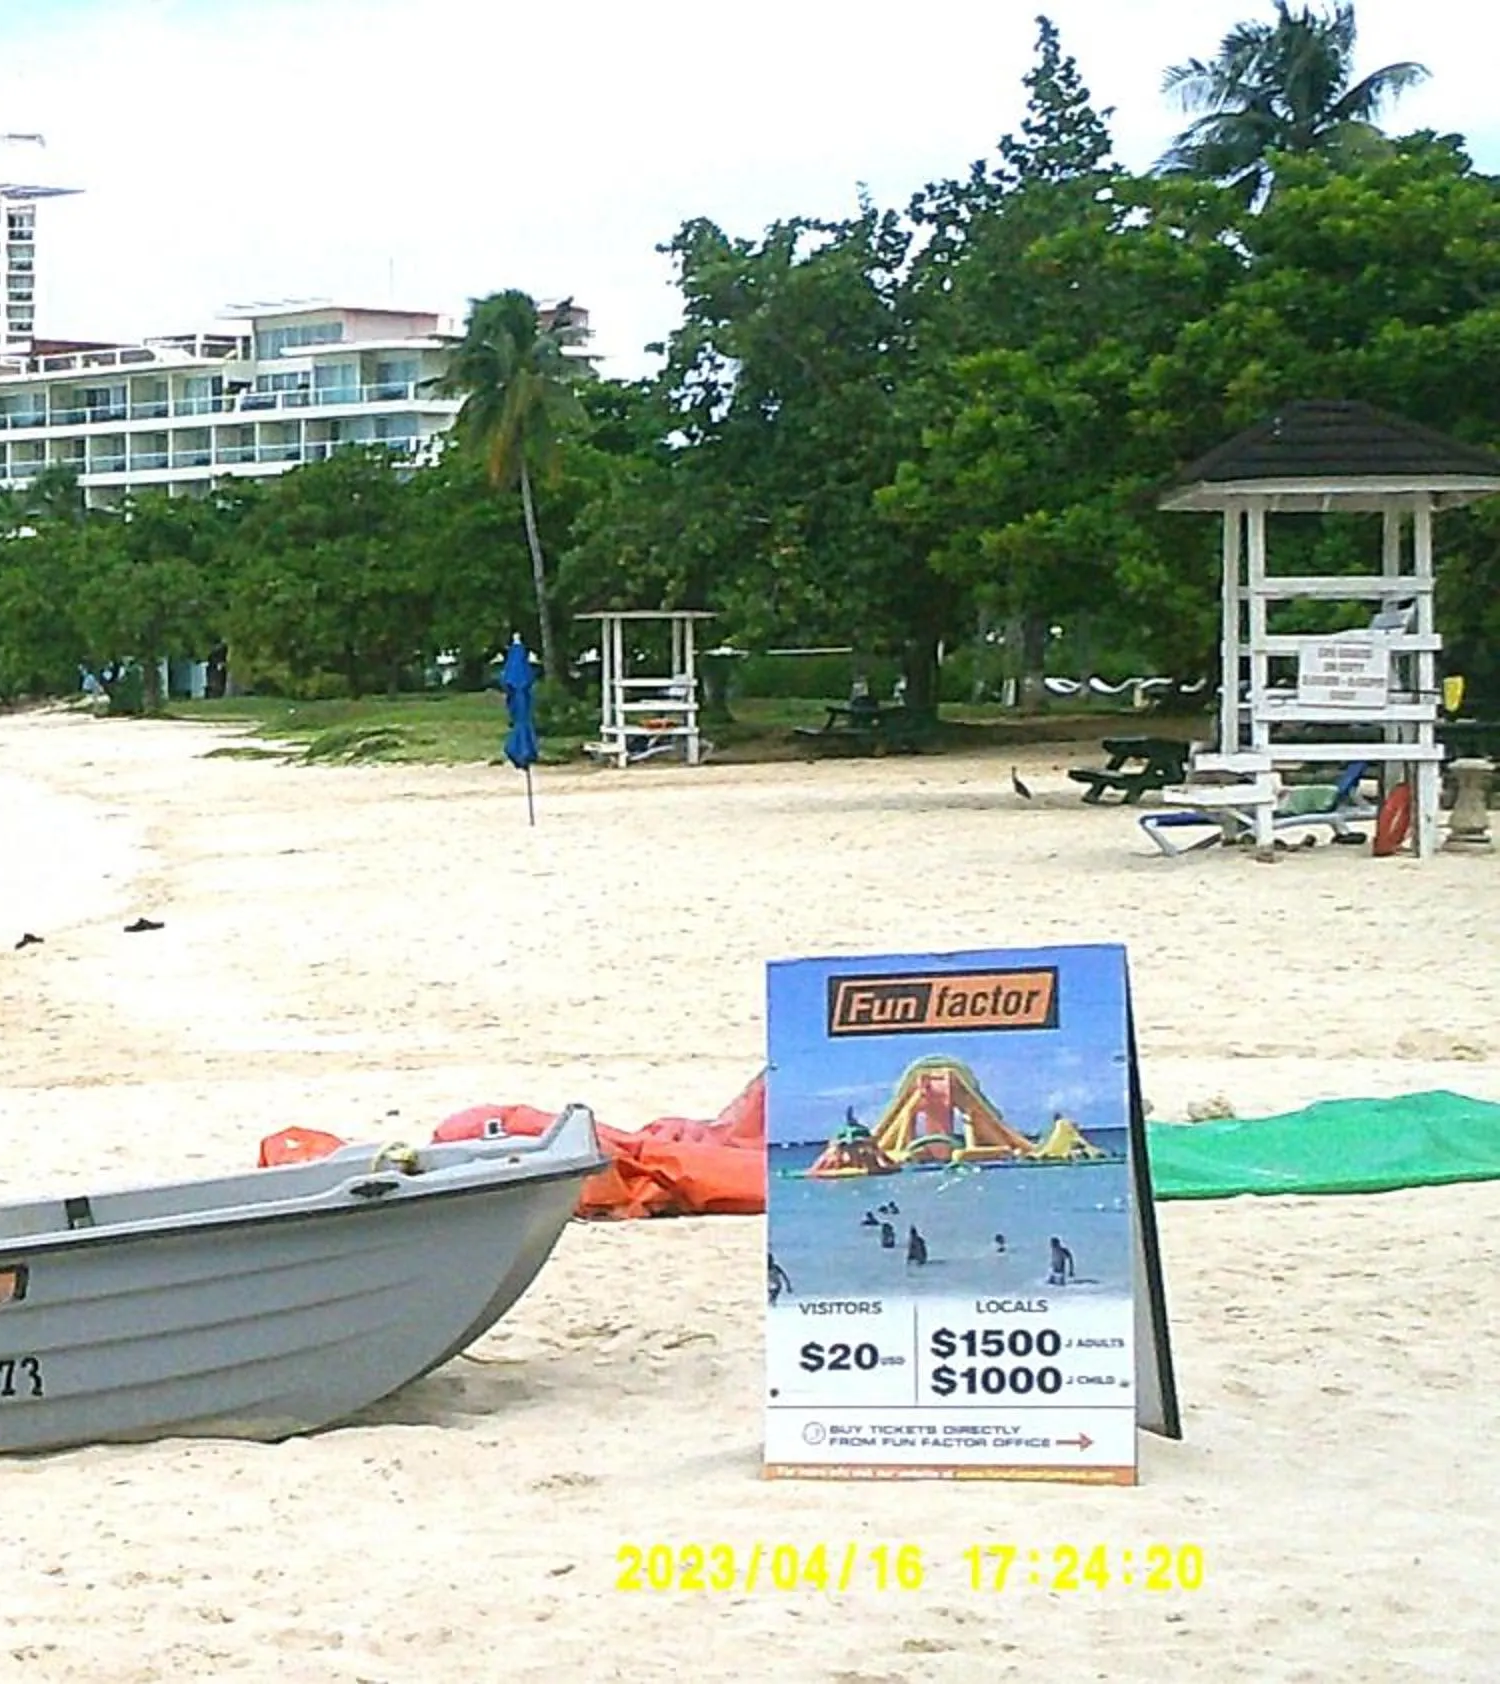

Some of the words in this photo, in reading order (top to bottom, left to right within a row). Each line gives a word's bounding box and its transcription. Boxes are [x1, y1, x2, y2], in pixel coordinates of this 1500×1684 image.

[848, 991, 917, 1022] Fun
[935, 984, 1041, 1018] factor
[799, 1301, 883, 1315] VISITORS
[976, 1299, 1049, 1314] LOCALS
[930, 1327, 1062, 1359] $1500
[1076, 1338, 1125, 1348] ADULTS
[799, 1341, 879, 1373] $20
[930, 1364, 1063, 1397] $1000
[1076, 1375, 1116, 1385] CHILD
[829, 1425, 863, 1435] BUY
[869, 1424, 938, 1435] TICKETS
[943, 1425, 1021, 1435] DIRECTLY
[829, 1437, 877, 1447] FROM
[882, 1437, 916, 1447] FUN
[921, 1437, 987, 1448] FACTOR
[992, 1437, 1051, 1448] OFFICE
